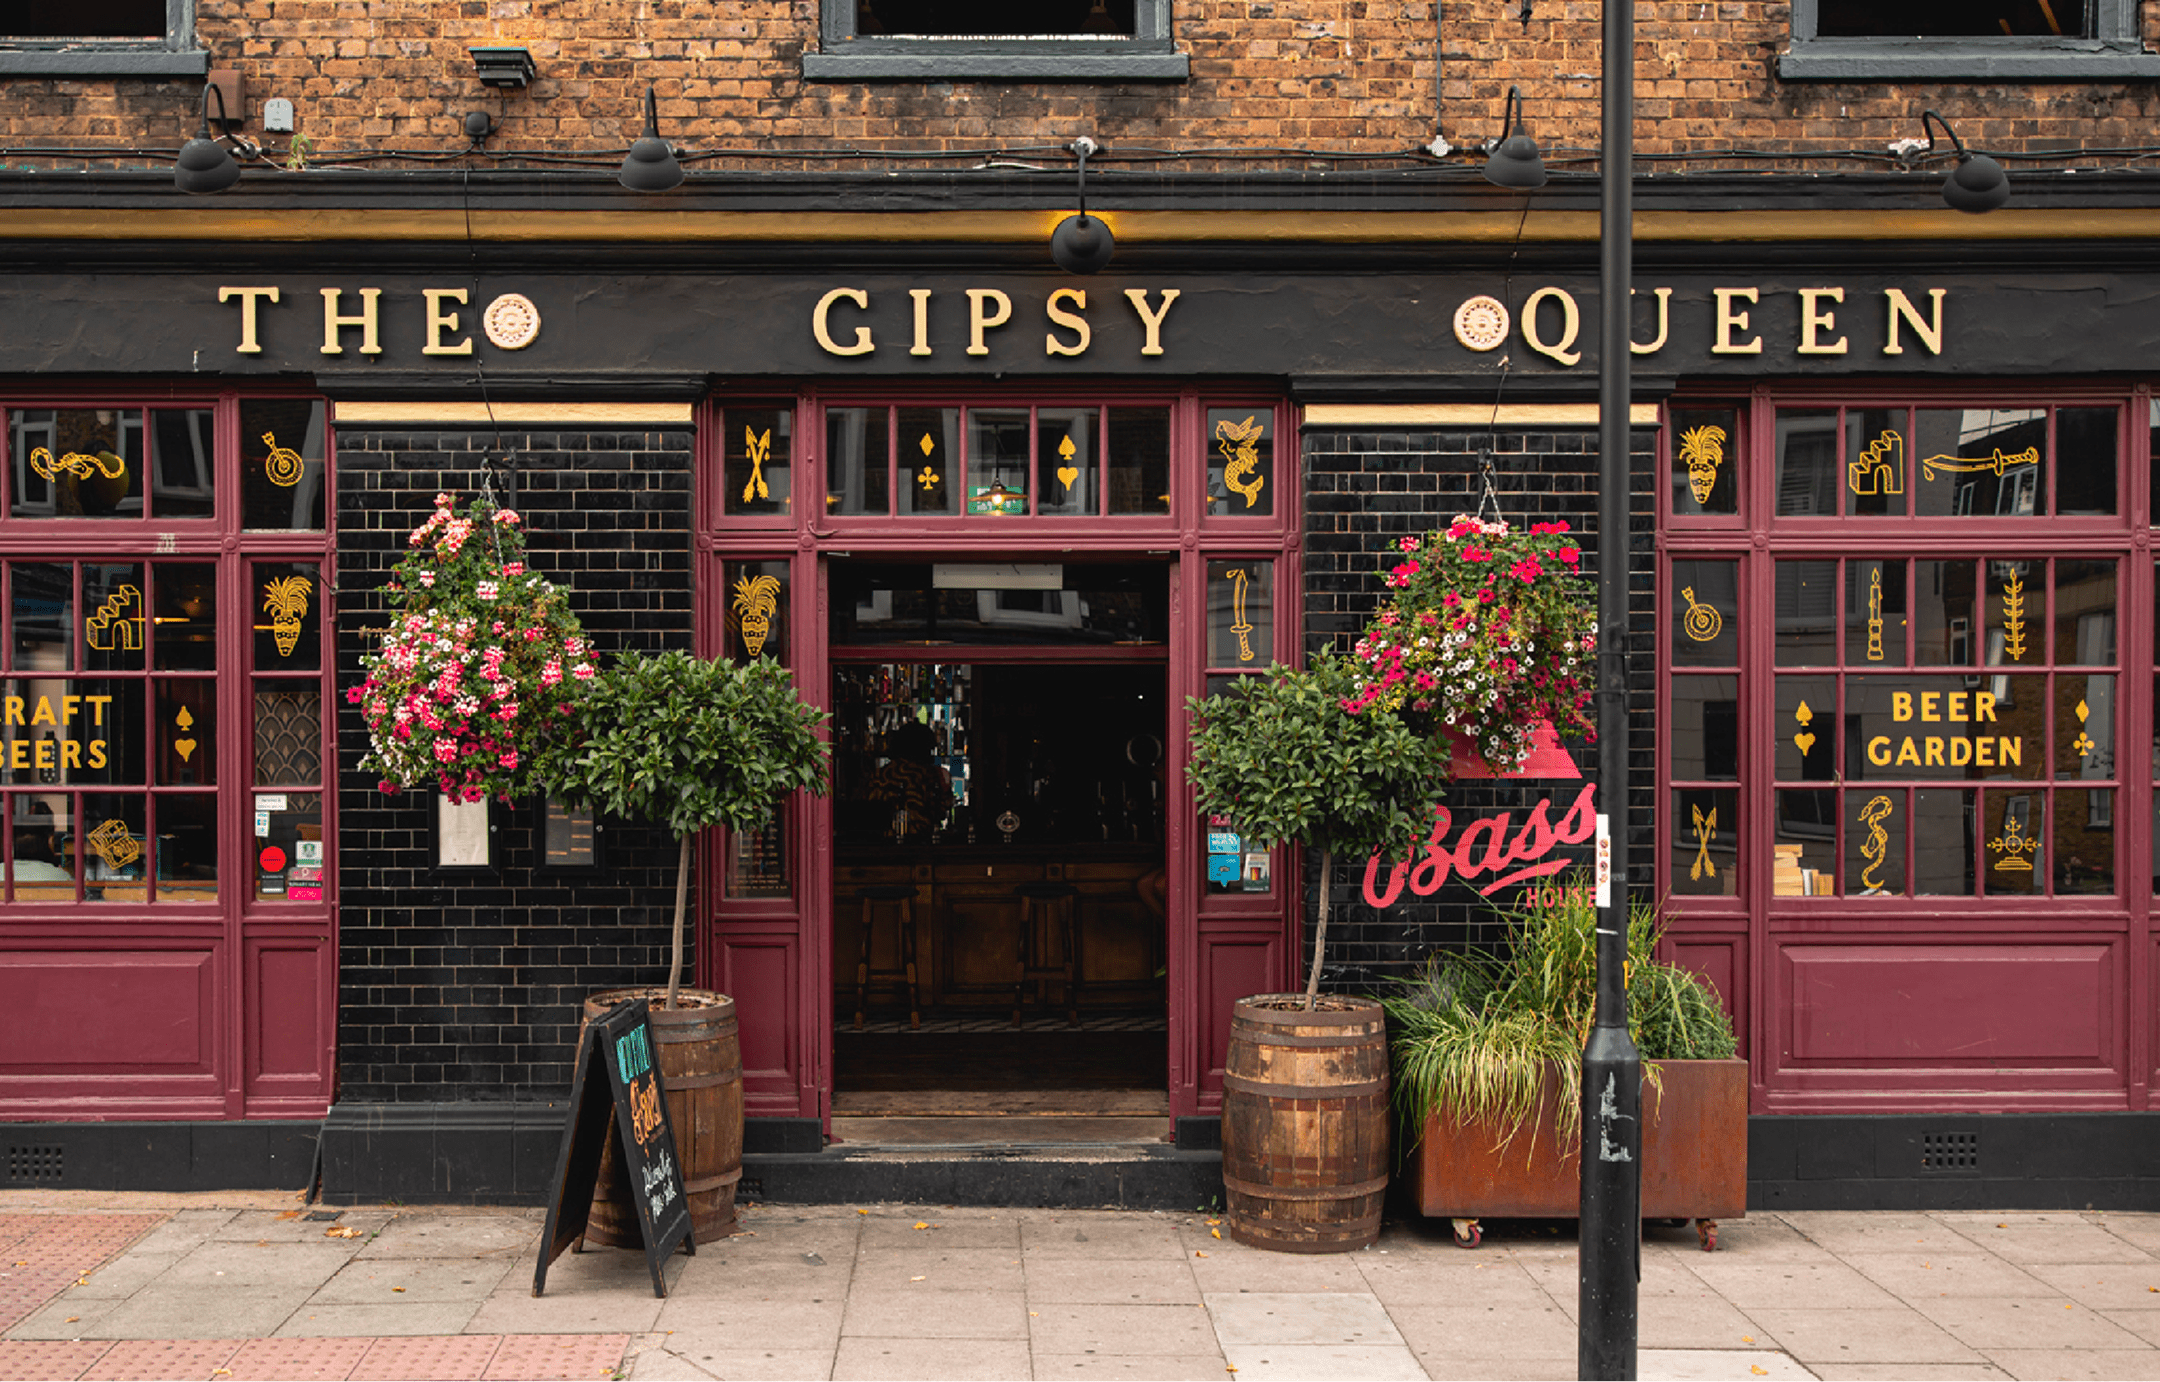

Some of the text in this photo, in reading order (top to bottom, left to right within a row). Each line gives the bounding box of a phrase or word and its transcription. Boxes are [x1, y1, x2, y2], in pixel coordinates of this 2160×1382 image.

[218, 286, 473, 355] THE
[812, 287, 1181, 356] GIPSY
[0, 695, 112, 726] RAFT
[1892, 691, 1997, 722] BEER
[0, 739, 107, 769] EERS
[1866, 736, 2022, 767] GARDEN
[1362, 782, 1597, 909] Bass
